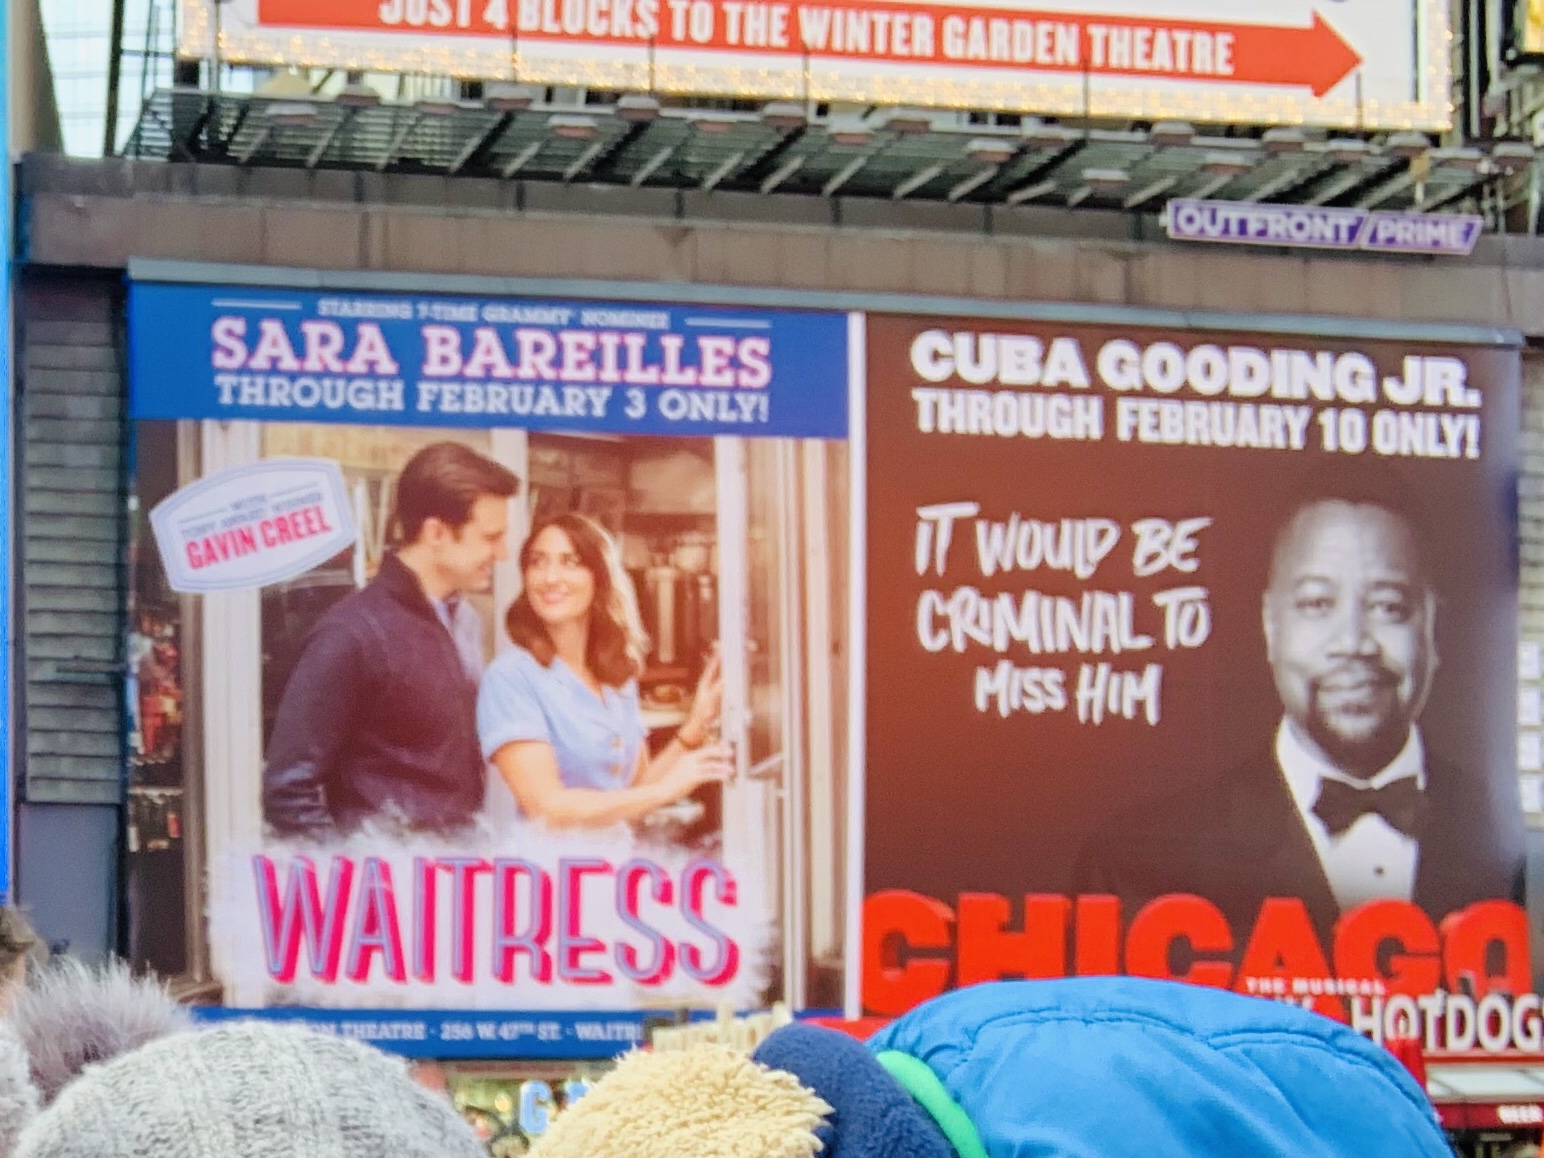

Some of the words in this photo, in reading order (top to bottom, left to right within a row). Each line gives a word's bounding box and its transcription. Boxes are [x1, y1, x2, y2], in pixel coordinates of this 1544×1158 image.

[378, 0, 471, 27] JUST
[483, 0, 509, 31] 4
[517, 0, 658, 38] BLOCKS
[670, 2, 713, 42] TO
[724, 3, 789, 48] THE
[798, 5, 934, 58] WINTER
[942, 14, 1079, 66] GARDEN
[1087, 23, 1235, 76] THEATRE
[211, 317, 399, 376] SARA
[422, 324, 772, 389] BAREILLES
[910, 330, 1091, 389] CUBA
[1097, 339, 1378, 403] GOODING
[1382, 354, 1483, 409] JR.
[214, 373, 404, 412] THROUGH
[417, 380, 613, 419] FEBRUARY
[624, 387, 648, 420] 3
[657, 387, 771, 424] ONLY!
[911, 387, 1103, 440] THROUGH
[1116, 396, 1311, 451] FEBRUARY
[1318, 408, 1366, 454] 10
[1372, 411, 1482, 460] ONLY!
[185, 524, 259, 570] GAVIN
[259, 504, 333, 549] CREEL
[914, 501, 981, 578] IT
[974, 510, 1122, 580] WOULD
[1130, 516, 1214, 577] BE
[915, 585, 1155, 654] CRIMINAL
[1151, 585, 1212, 651] TO
[973, 658, 1068, 718] MISS
[1075, 661, 1164, 727] HIM
[251, 854, 741, 987] WAITRESS
[860, 889, 1533, 1016] CHICAGO
[1245, 976, 1287, 995] THE
[1291, 976, 1388, 996] MUSICAL
[340, 1021, 426, 1041] THEATRE
